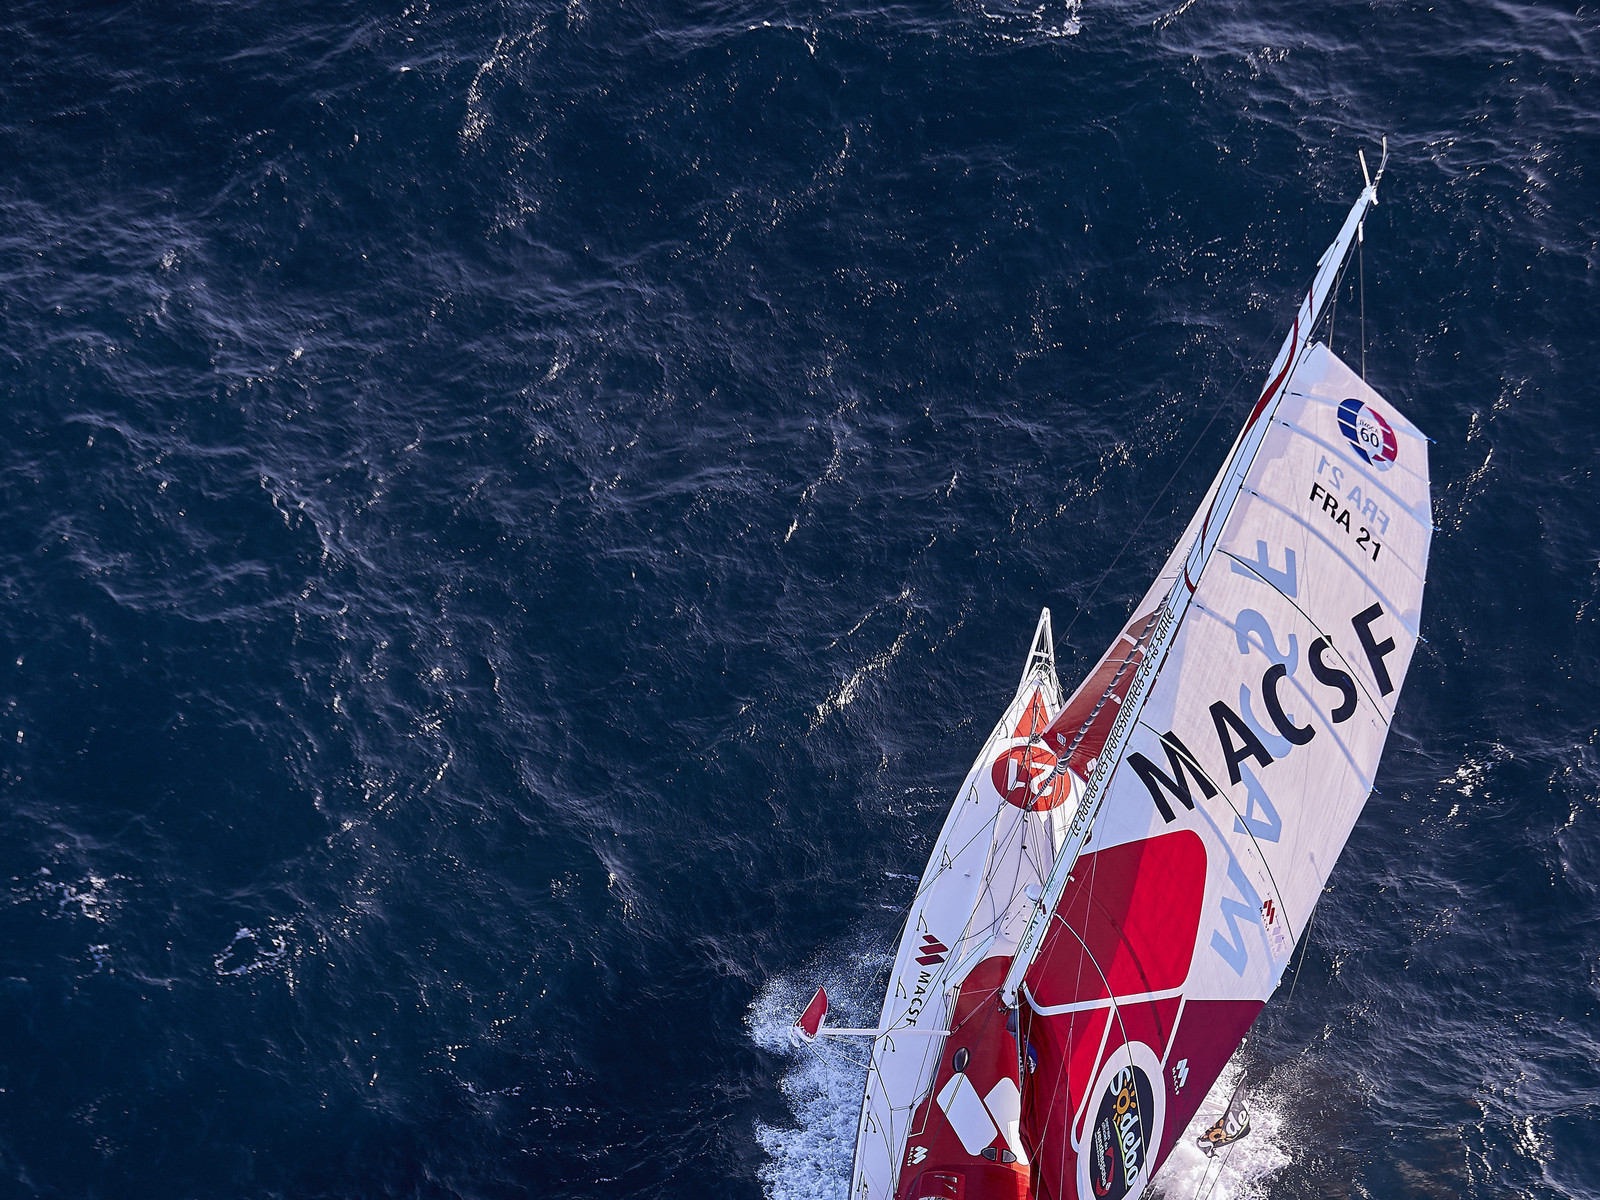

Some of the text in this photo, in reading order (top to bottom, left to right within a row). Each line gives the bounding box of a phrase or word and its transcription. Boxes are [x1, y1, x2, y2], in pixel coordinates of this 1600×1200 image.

[1361, 427, 1379, 448] 60
[1309, 482, 1381, 562] FRA 21
[1126, 602, 1396, 824] MACSF
[905, 970, 931, 1027] MACSF
[1110, 1067, 1141, 1186] Sodebo
